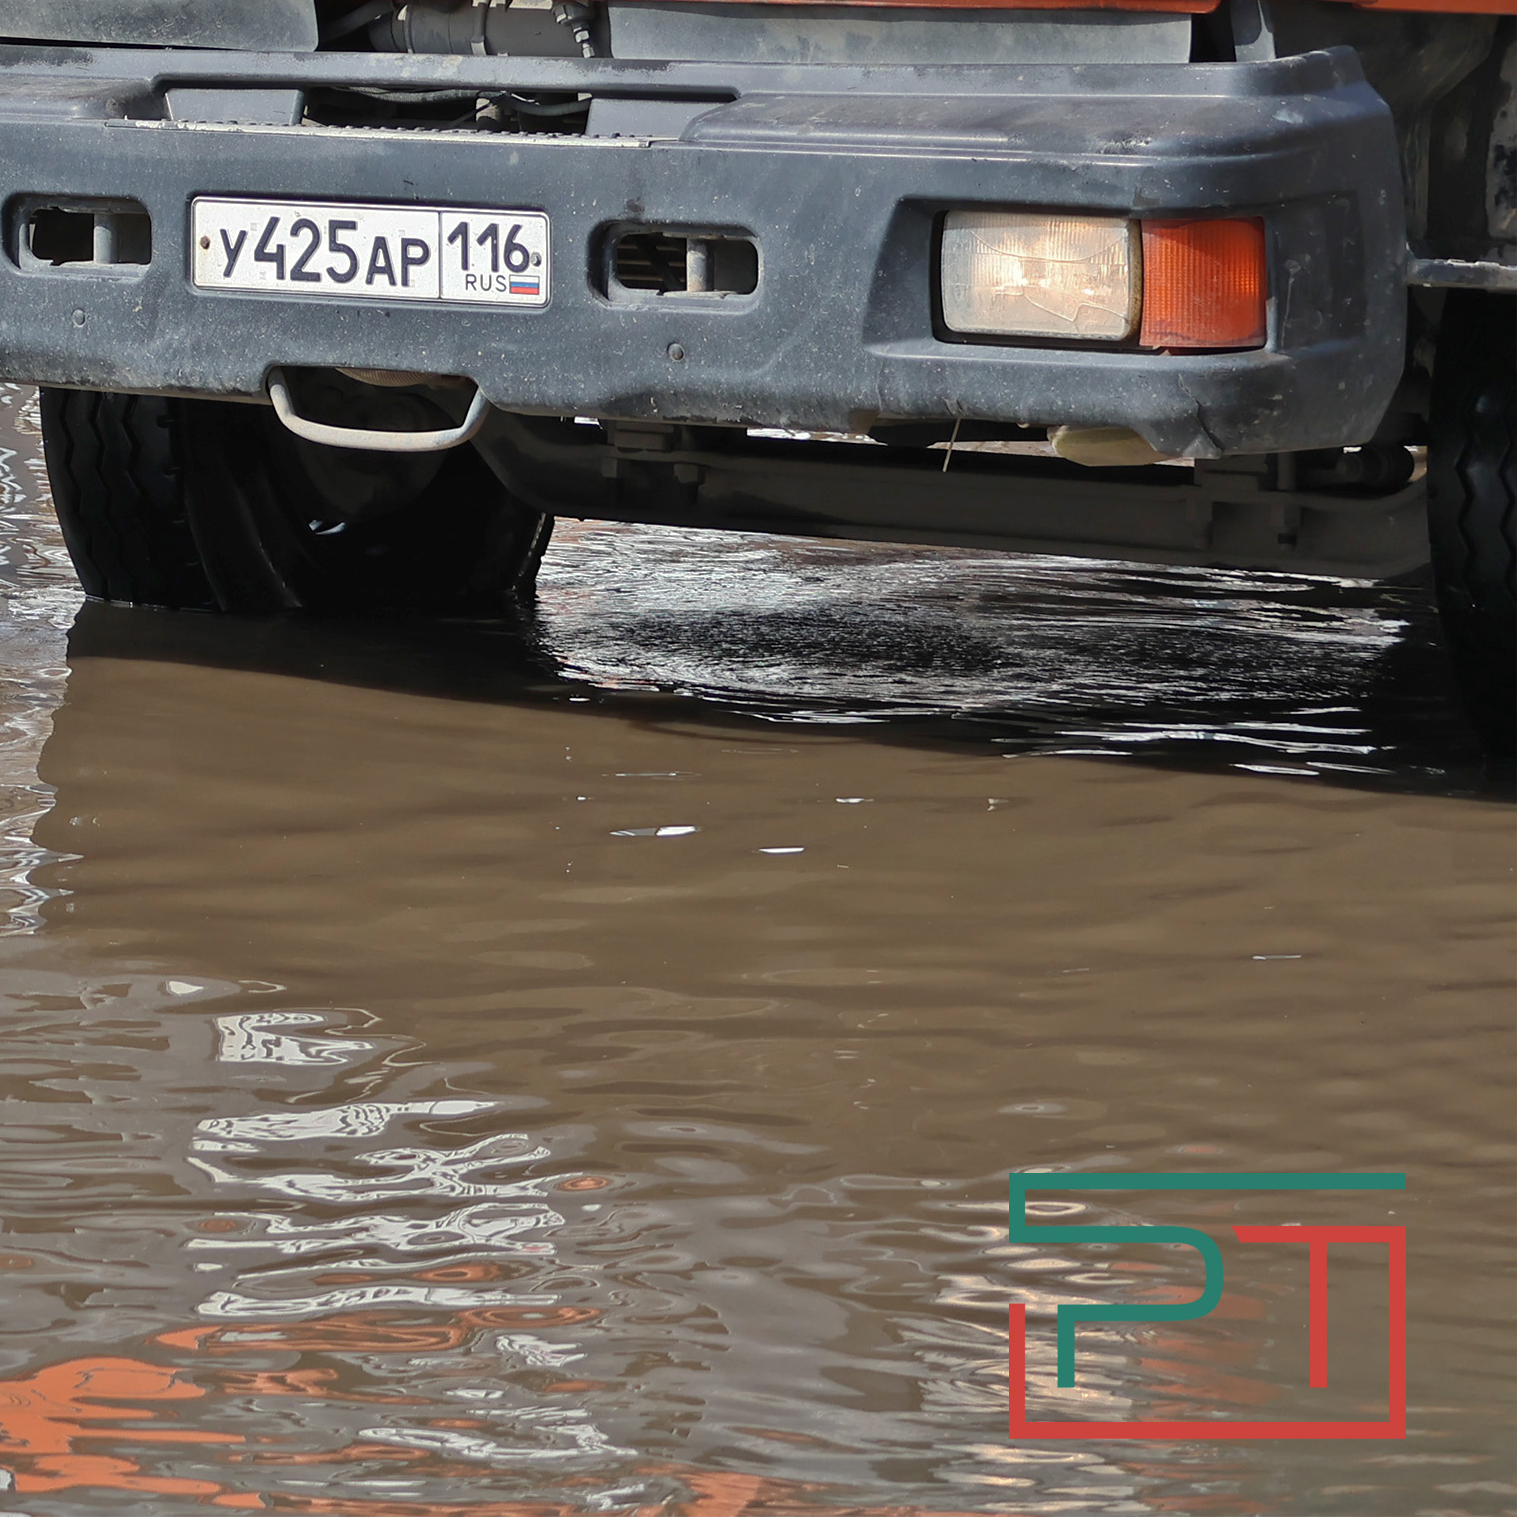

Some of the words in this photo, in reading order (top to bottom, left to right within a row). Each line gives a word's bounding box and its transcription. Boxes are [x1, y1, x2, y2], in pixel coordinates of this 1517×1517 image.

[219, 216, 431, 288] У425АР
[447, 221, 531, 274] 116
[465, 273, 507, 292] RUS
